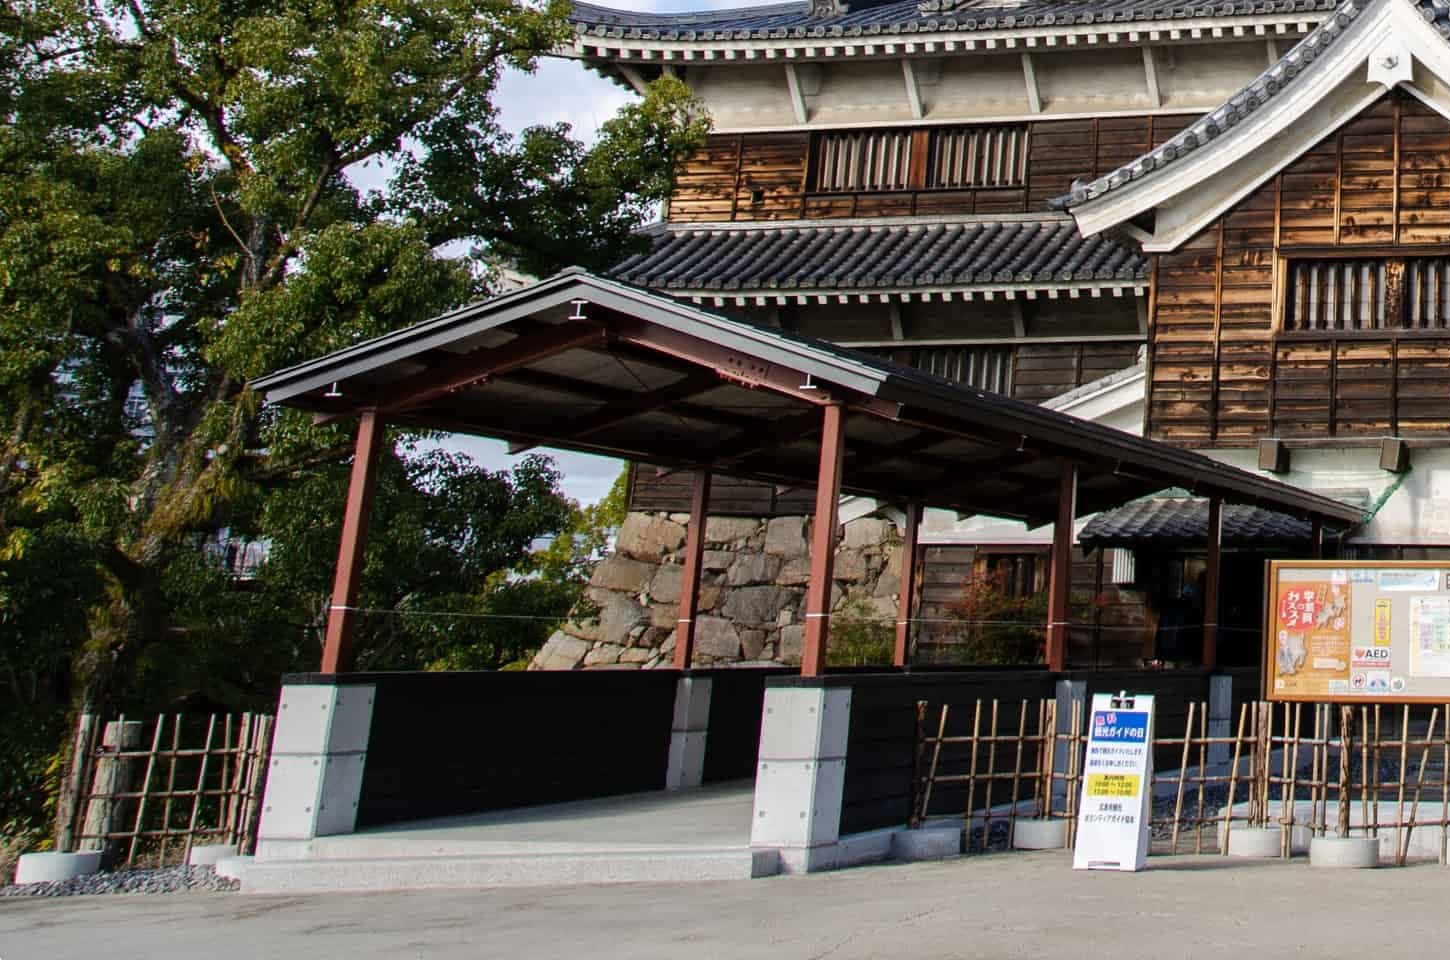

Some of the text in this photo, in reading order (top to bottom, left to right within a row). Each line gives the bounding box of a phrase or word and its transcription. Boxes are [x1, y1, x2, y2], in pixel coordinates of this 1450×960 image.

[1365, 649, 1389, 658] AED
[1094, 726, 1145, 738] 観光ガイドの日
